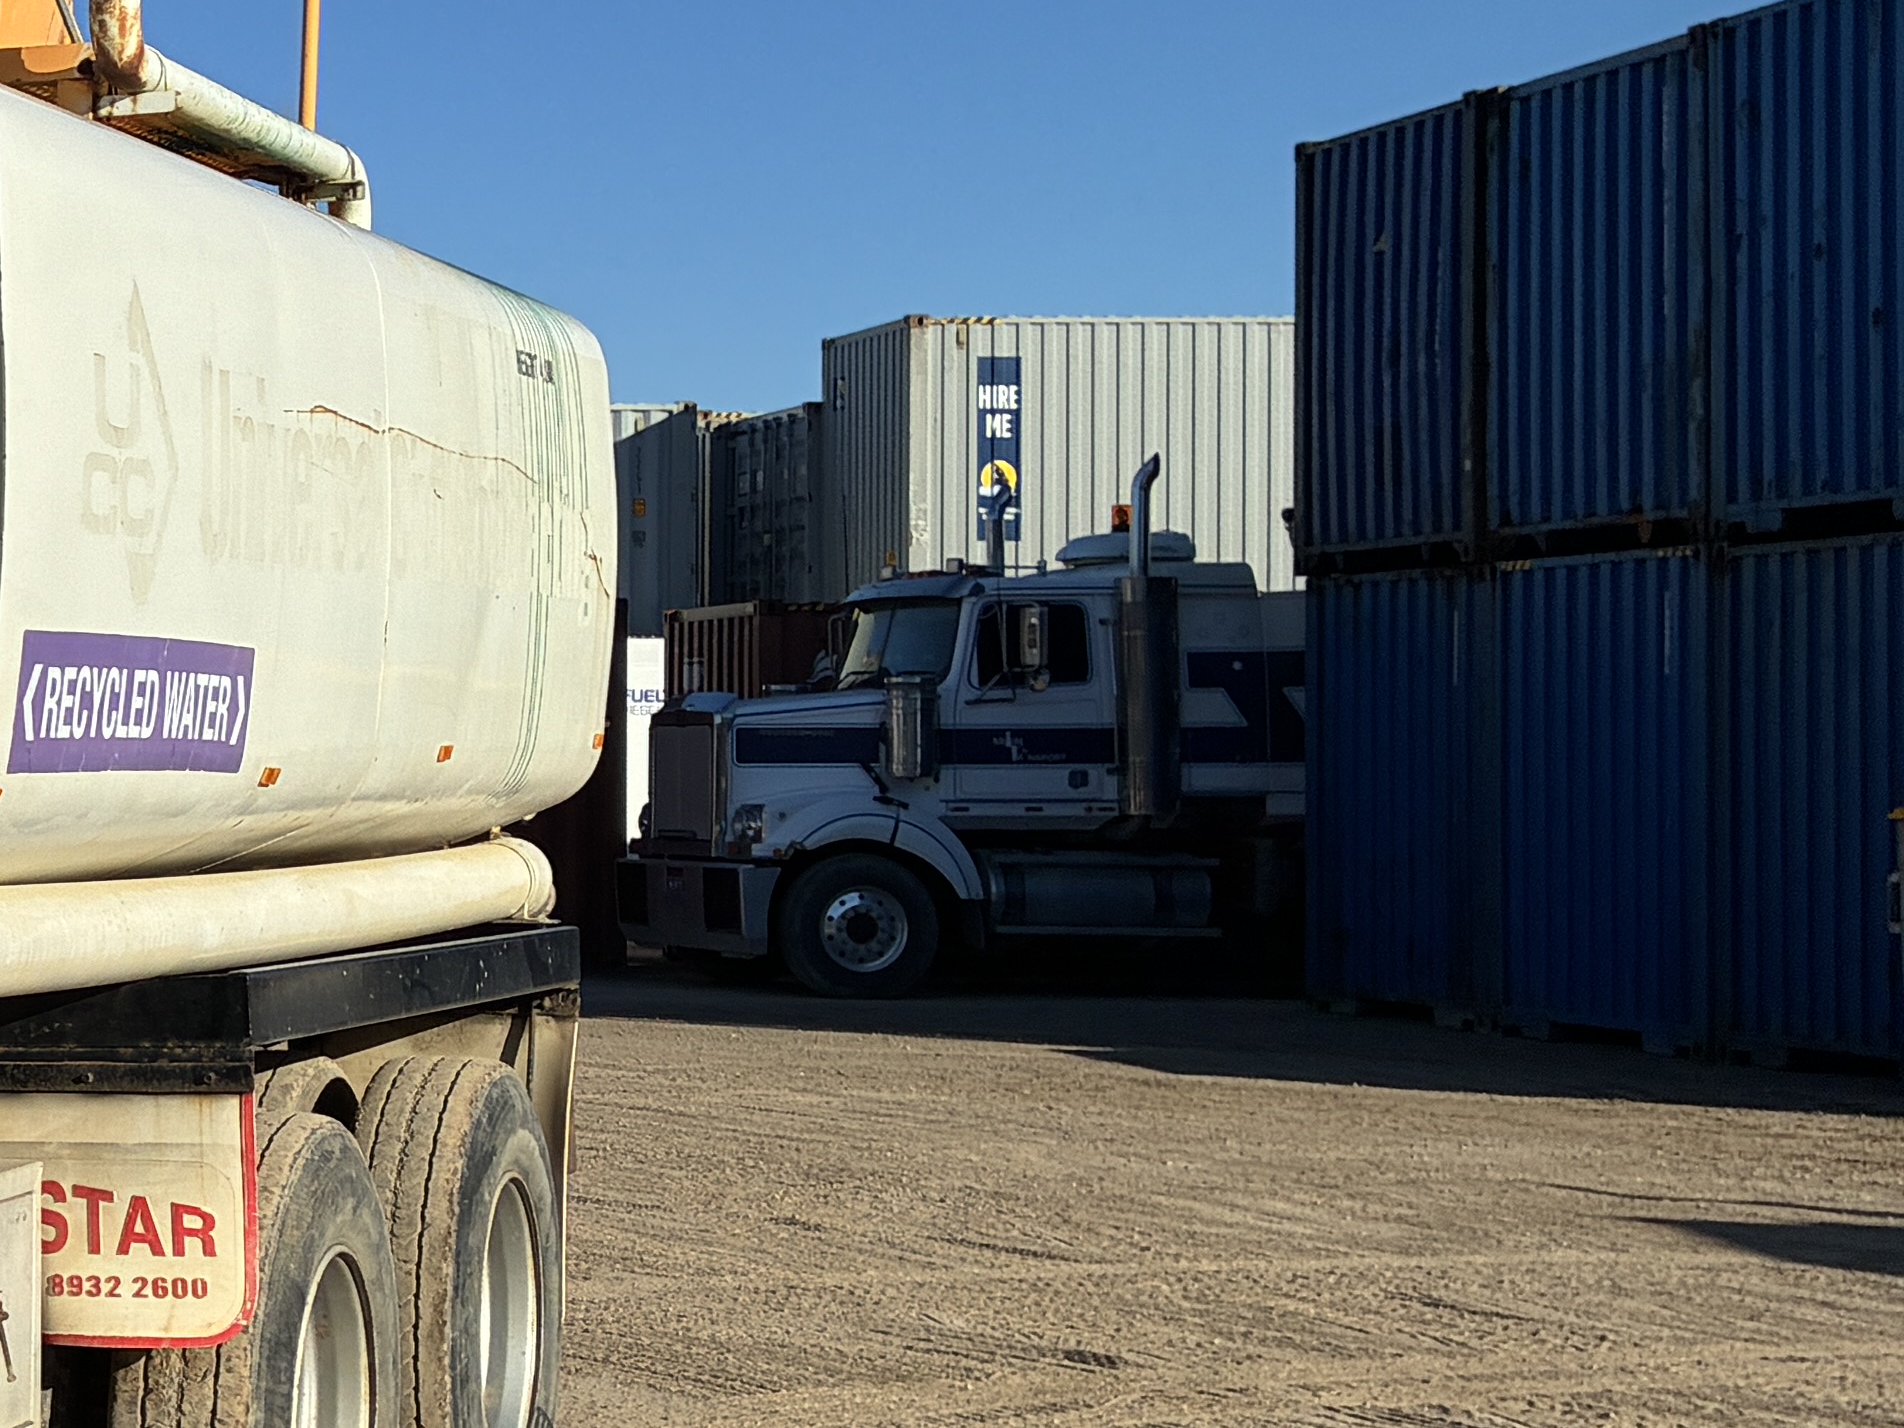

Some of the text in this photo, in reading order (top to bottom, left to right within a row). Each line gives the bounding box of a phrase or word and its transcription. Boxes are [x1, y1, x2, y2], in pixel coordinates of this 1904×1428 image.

[978, 385, 1019, 409] HIRE
[986, 413, 1012, 438] ME
[40, 665, 232, 742] RECYCLED WATER
[41, 1180, 217, 1258] STAR
[46, 1273, 208, 1300] 8932 2600
